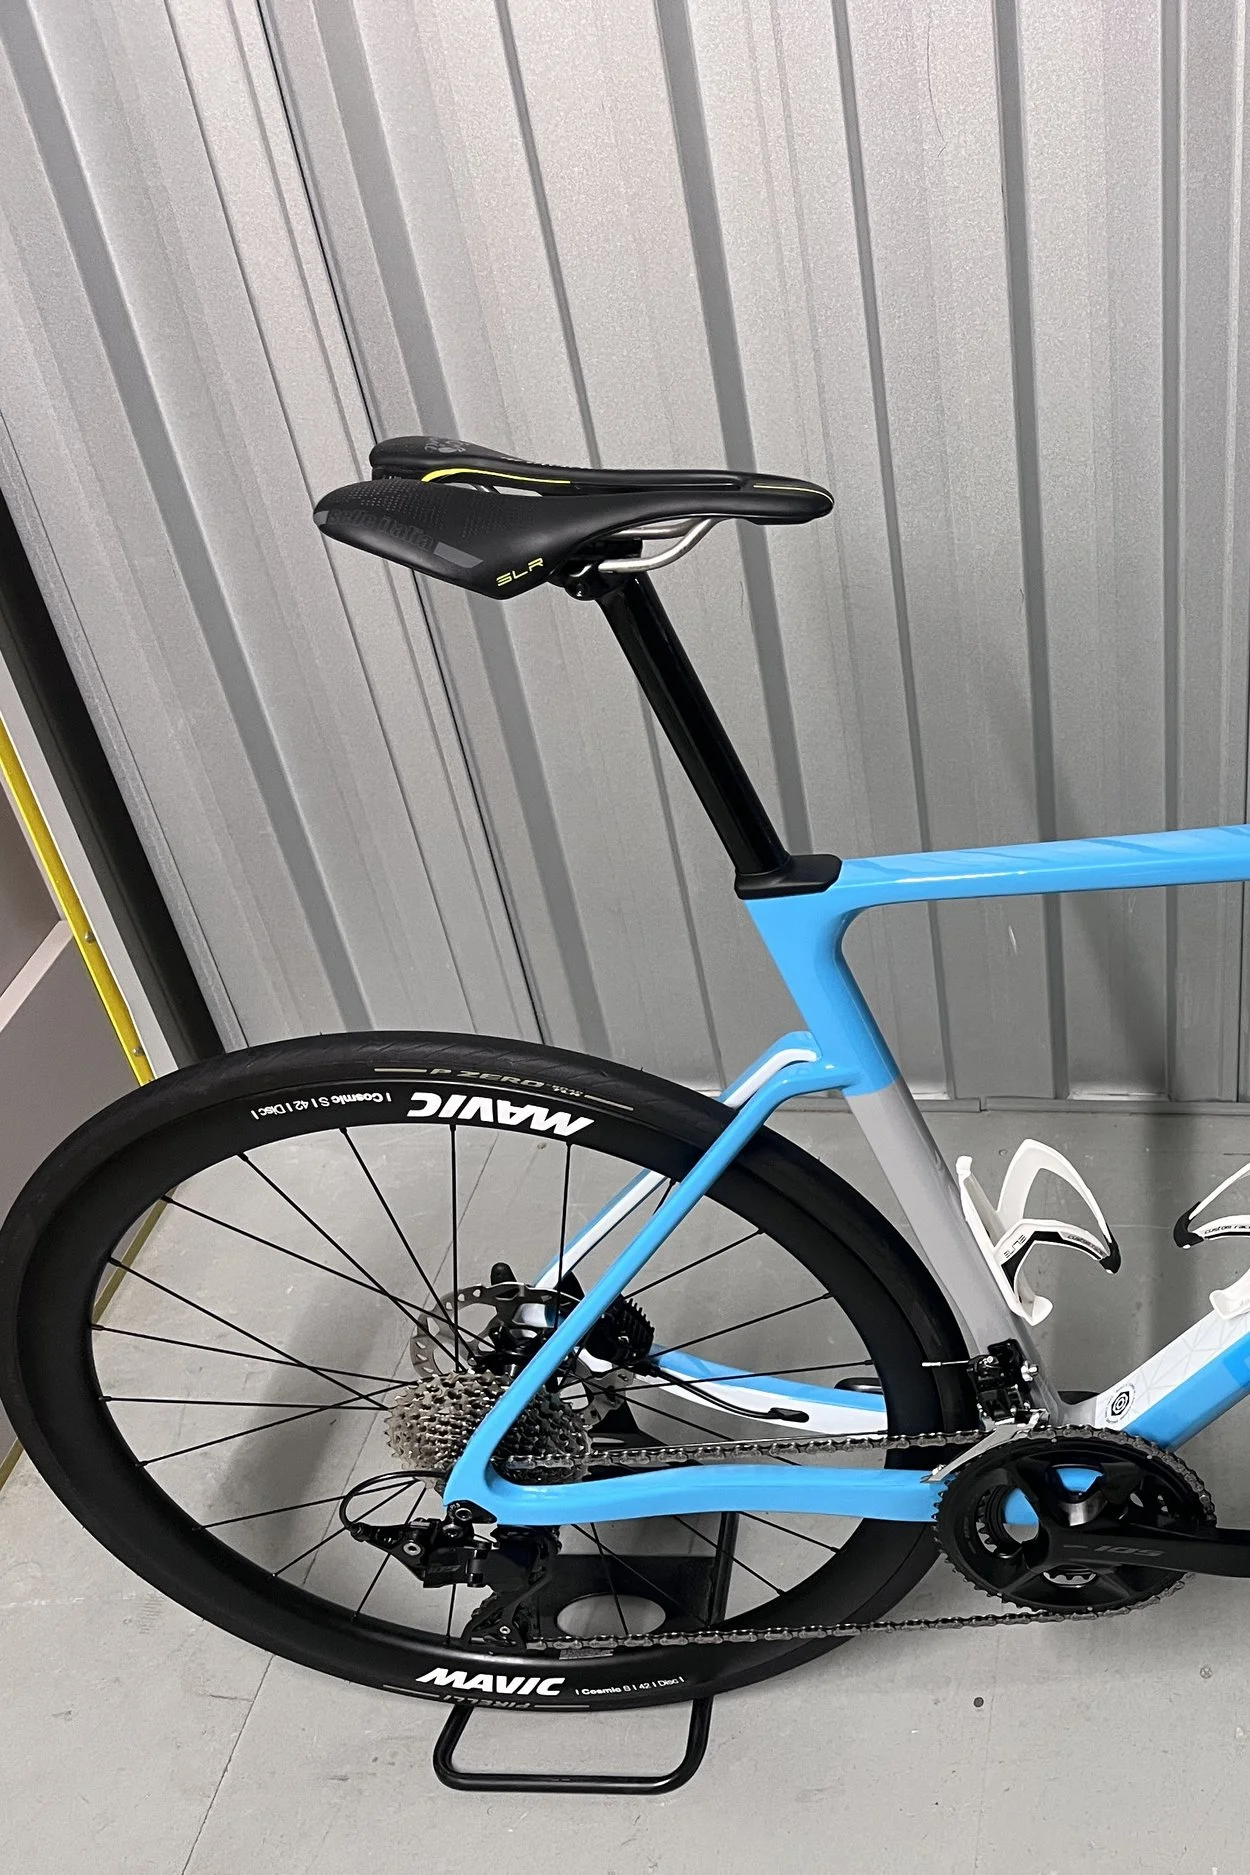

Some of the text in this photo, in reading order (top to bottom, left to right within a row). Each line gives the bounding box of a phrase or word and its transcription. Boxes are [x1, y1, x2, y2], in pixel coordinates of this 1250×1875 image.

[496, 557, 544, 587] SLR
[430, 1067, 545, 1088] P ZERO
[257, 1092, 384, 1116] Cosmic S 42 Disc
[406, 1091, 595, 1137] MAVIC
[1094, 1545, 1165, 1557] 105
[415, 1667, 566, 1696] MAVIC
[581, 1686, 622, 1696] Cosmic
[638, 1682, 652, 1690] 42
[657, 1678, 680, 1687] Disc
[443, 1694, 532, 1709] PIRELLI
